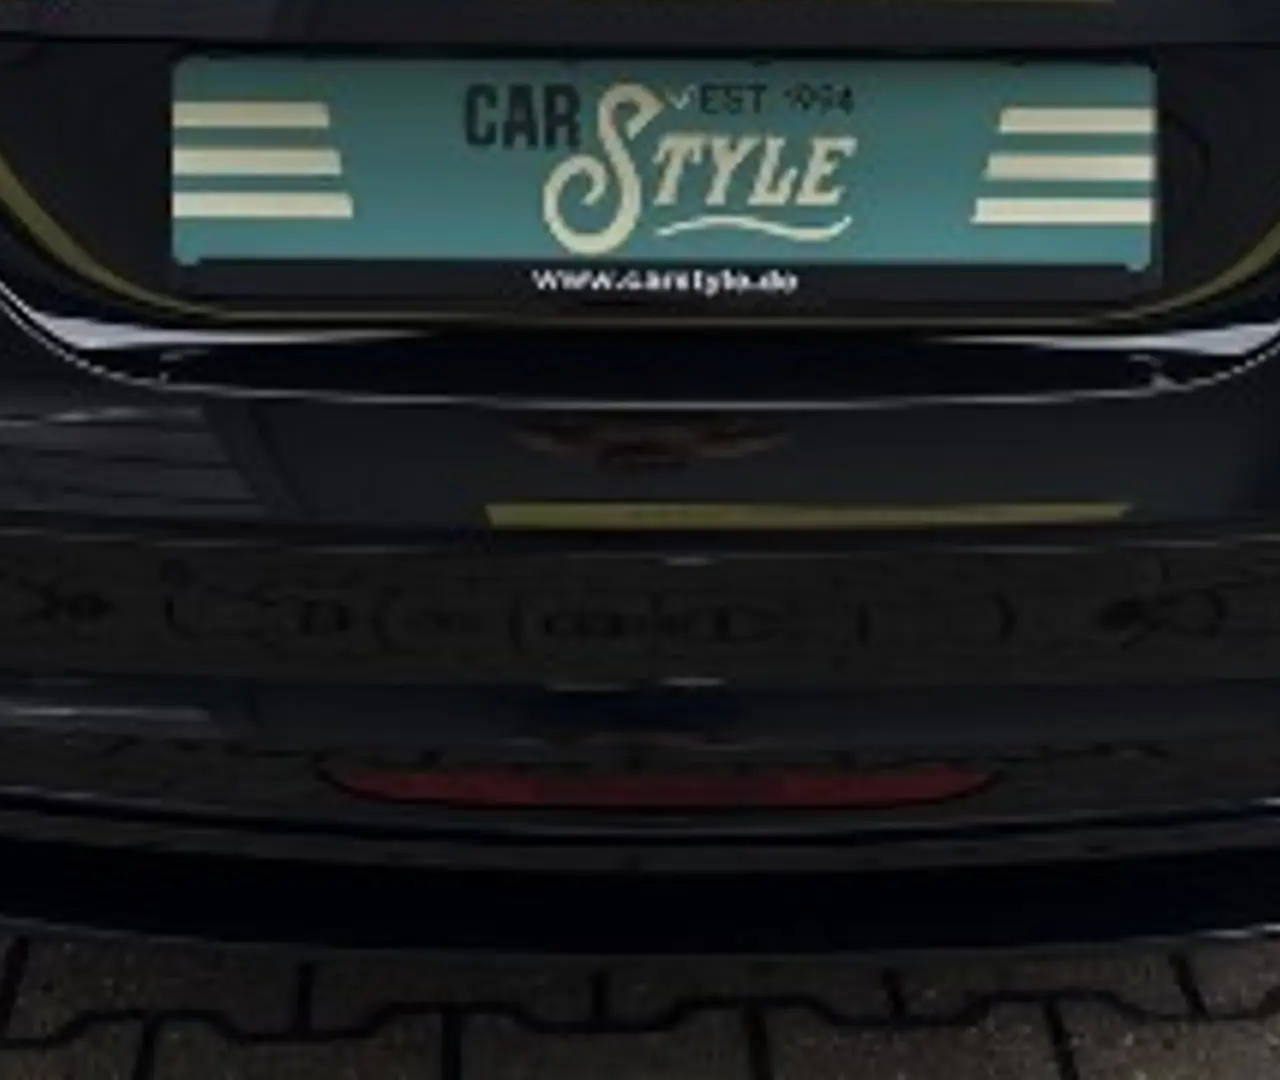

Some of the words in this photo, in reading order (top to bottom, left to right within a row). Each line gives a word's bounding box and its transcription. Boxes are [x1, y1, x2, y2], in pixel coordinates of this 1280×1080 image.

[464, 83, 582, 149] CAR
[701, 83, 768, 114] EST
[542, 81, 858, 255] STYLE
[531, 267, 799, 298] www.carstyle.de
